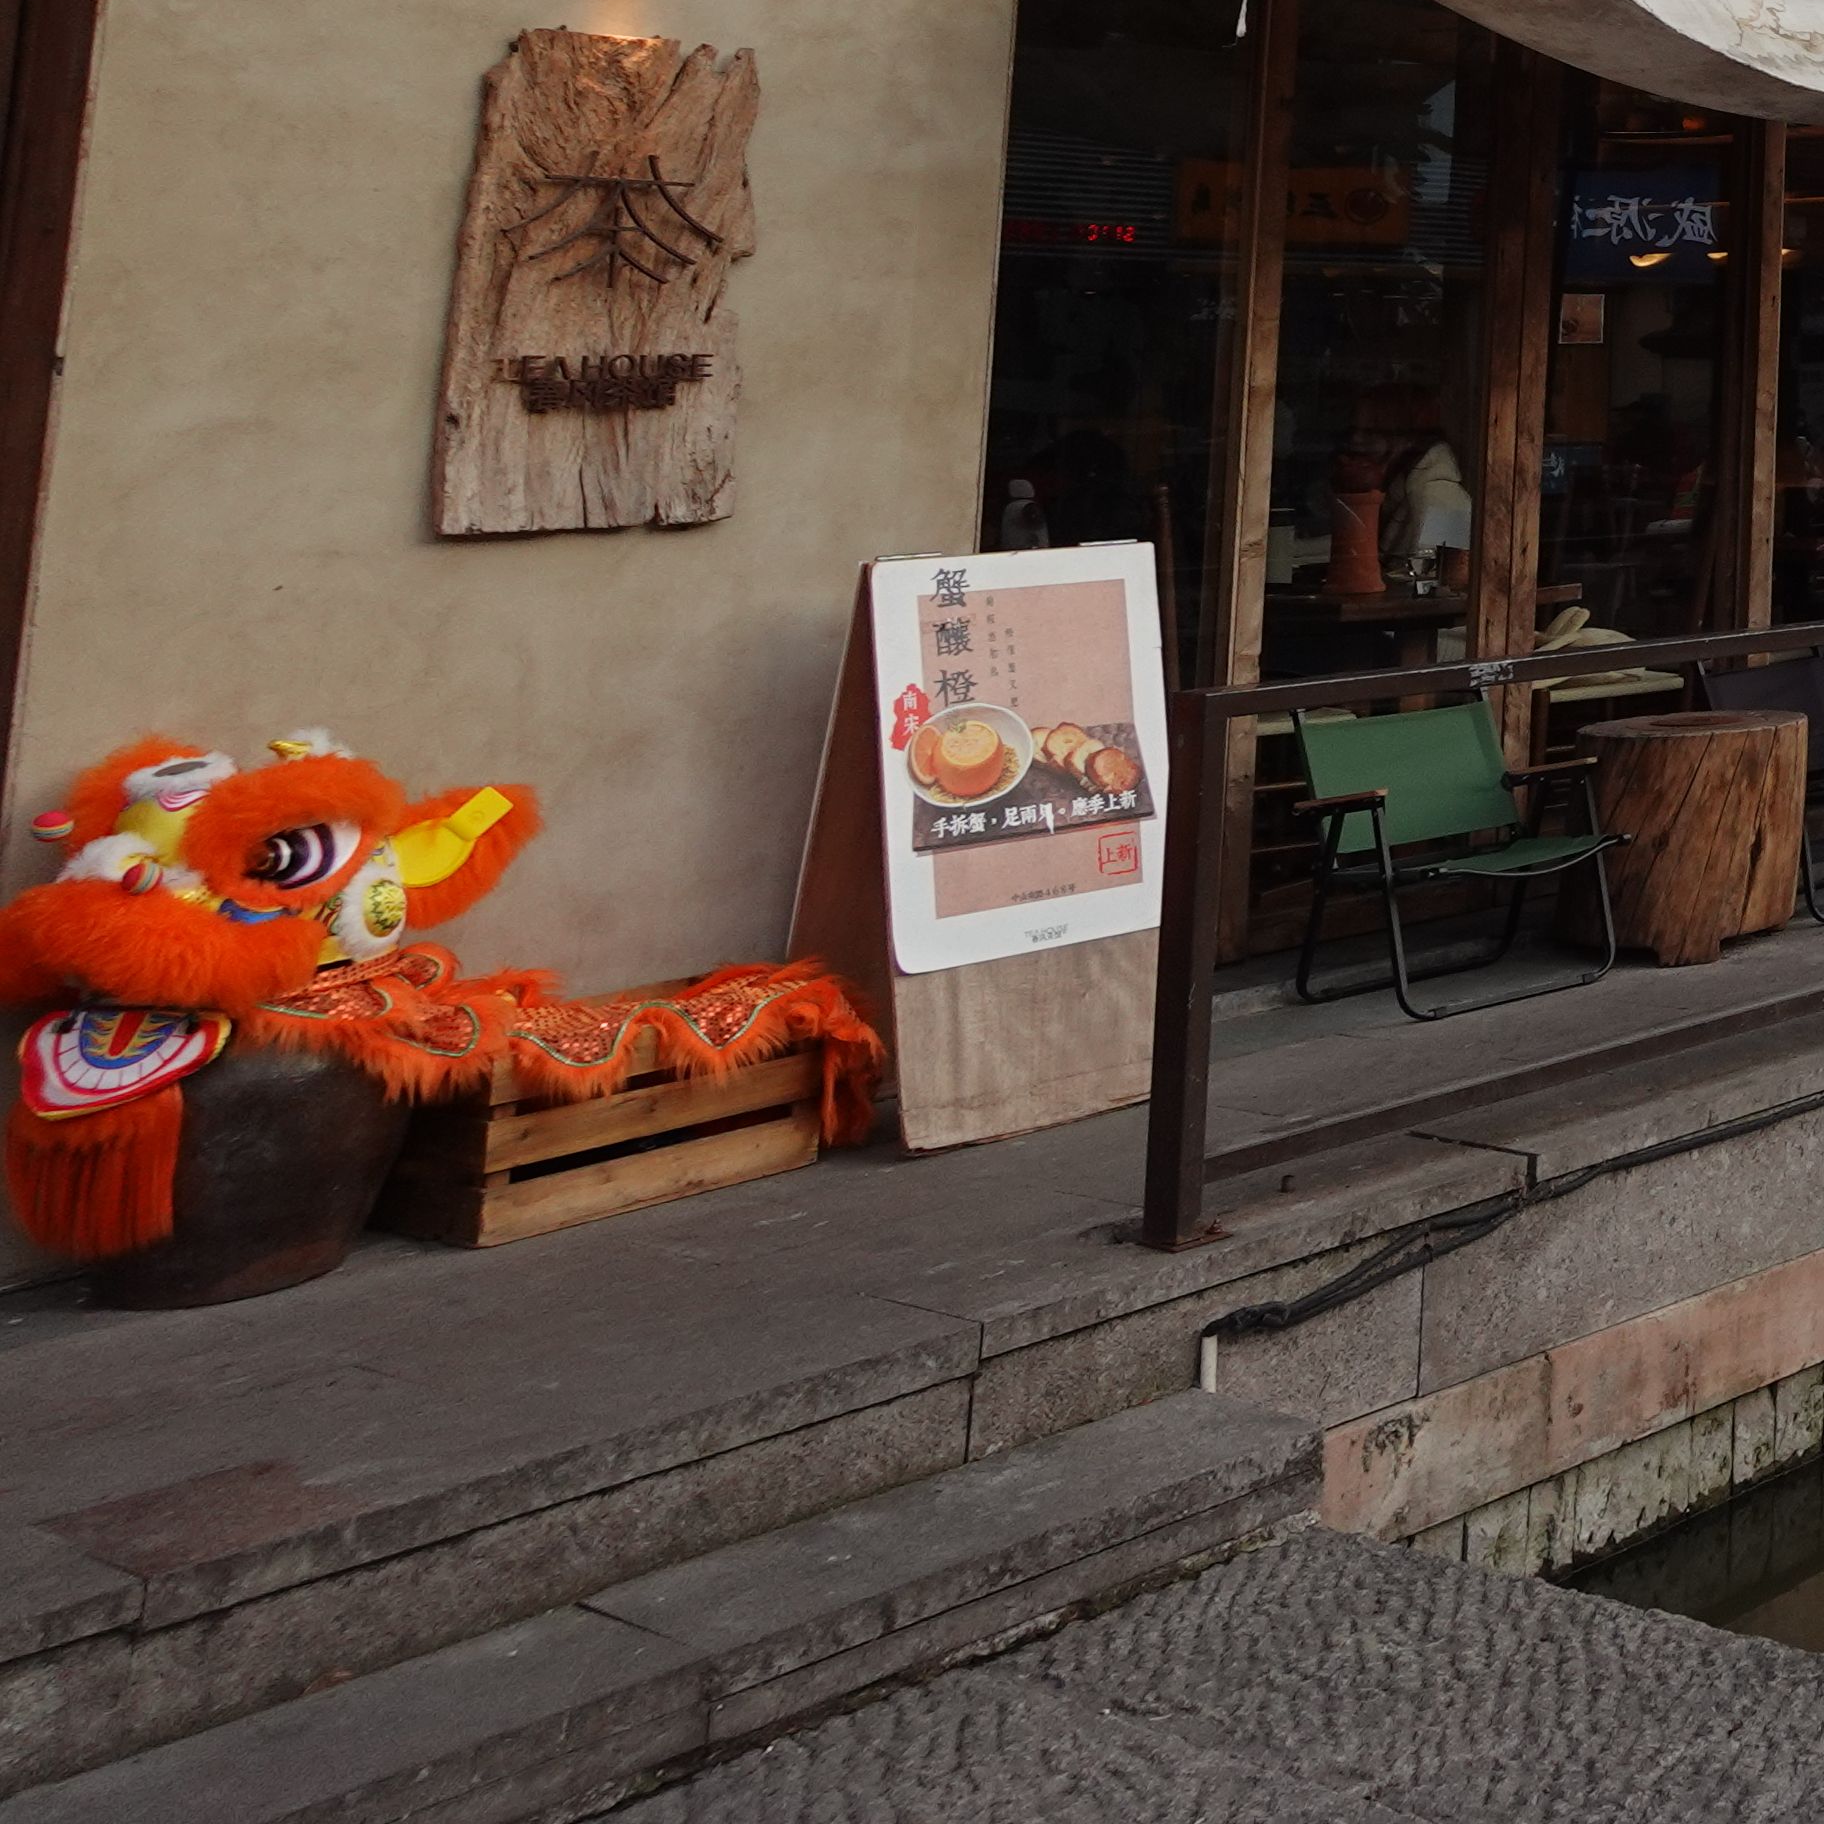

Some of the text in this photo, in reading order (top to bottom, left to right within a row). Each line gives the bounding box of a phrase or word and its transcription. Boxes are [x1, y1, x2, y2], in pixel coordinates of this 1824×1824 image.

[492, 353, 714, 381] TEA HOUSE
[930, 567, 978, 706] 蟹釀橙
[901, 691, 920, 734] 南宋
